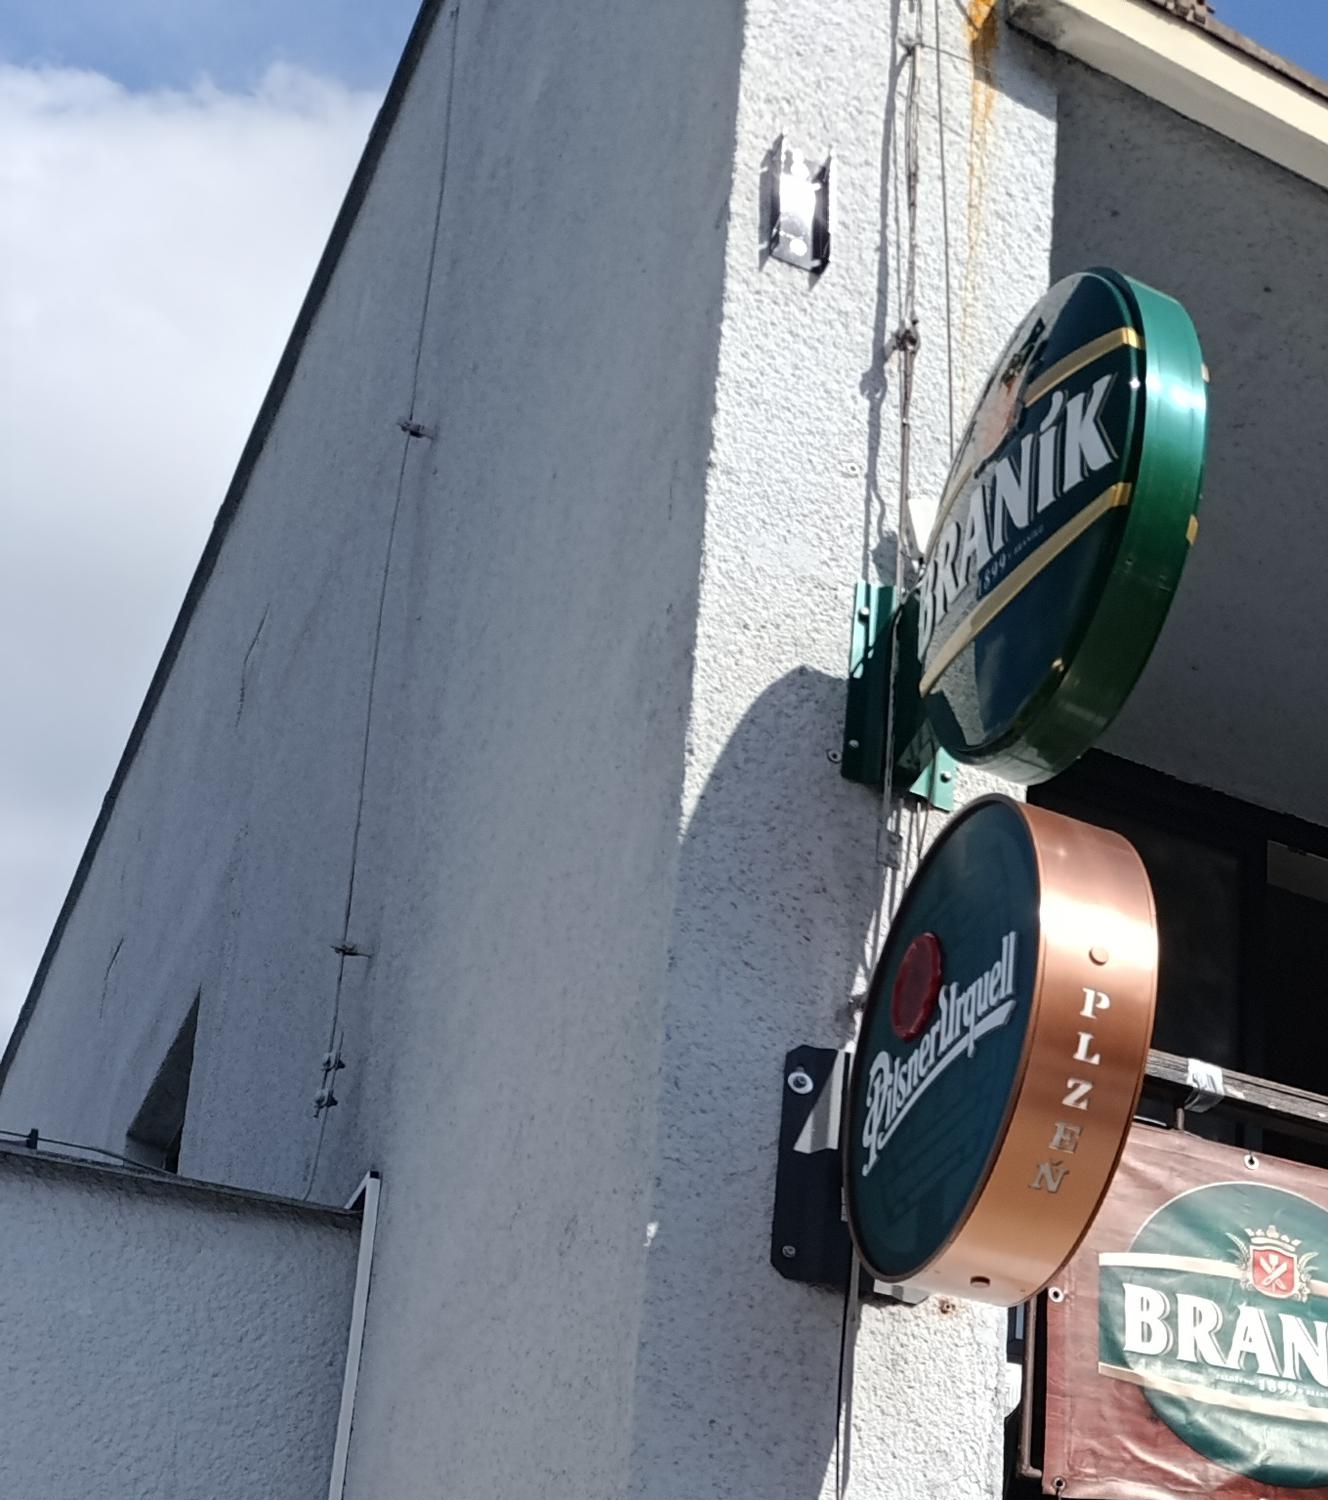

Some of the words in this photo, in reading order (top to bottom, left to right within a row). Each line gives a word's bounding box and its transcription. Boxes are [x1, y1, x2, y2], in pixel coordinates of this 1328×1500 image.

[918, 373, 1118, 650] BRANÍK
[861, 1019, 942, 1177] Pilsner
[937, 930, 1017, 1058] Urquell
[1028, 986, 1112, 1194] PLZEŇ
